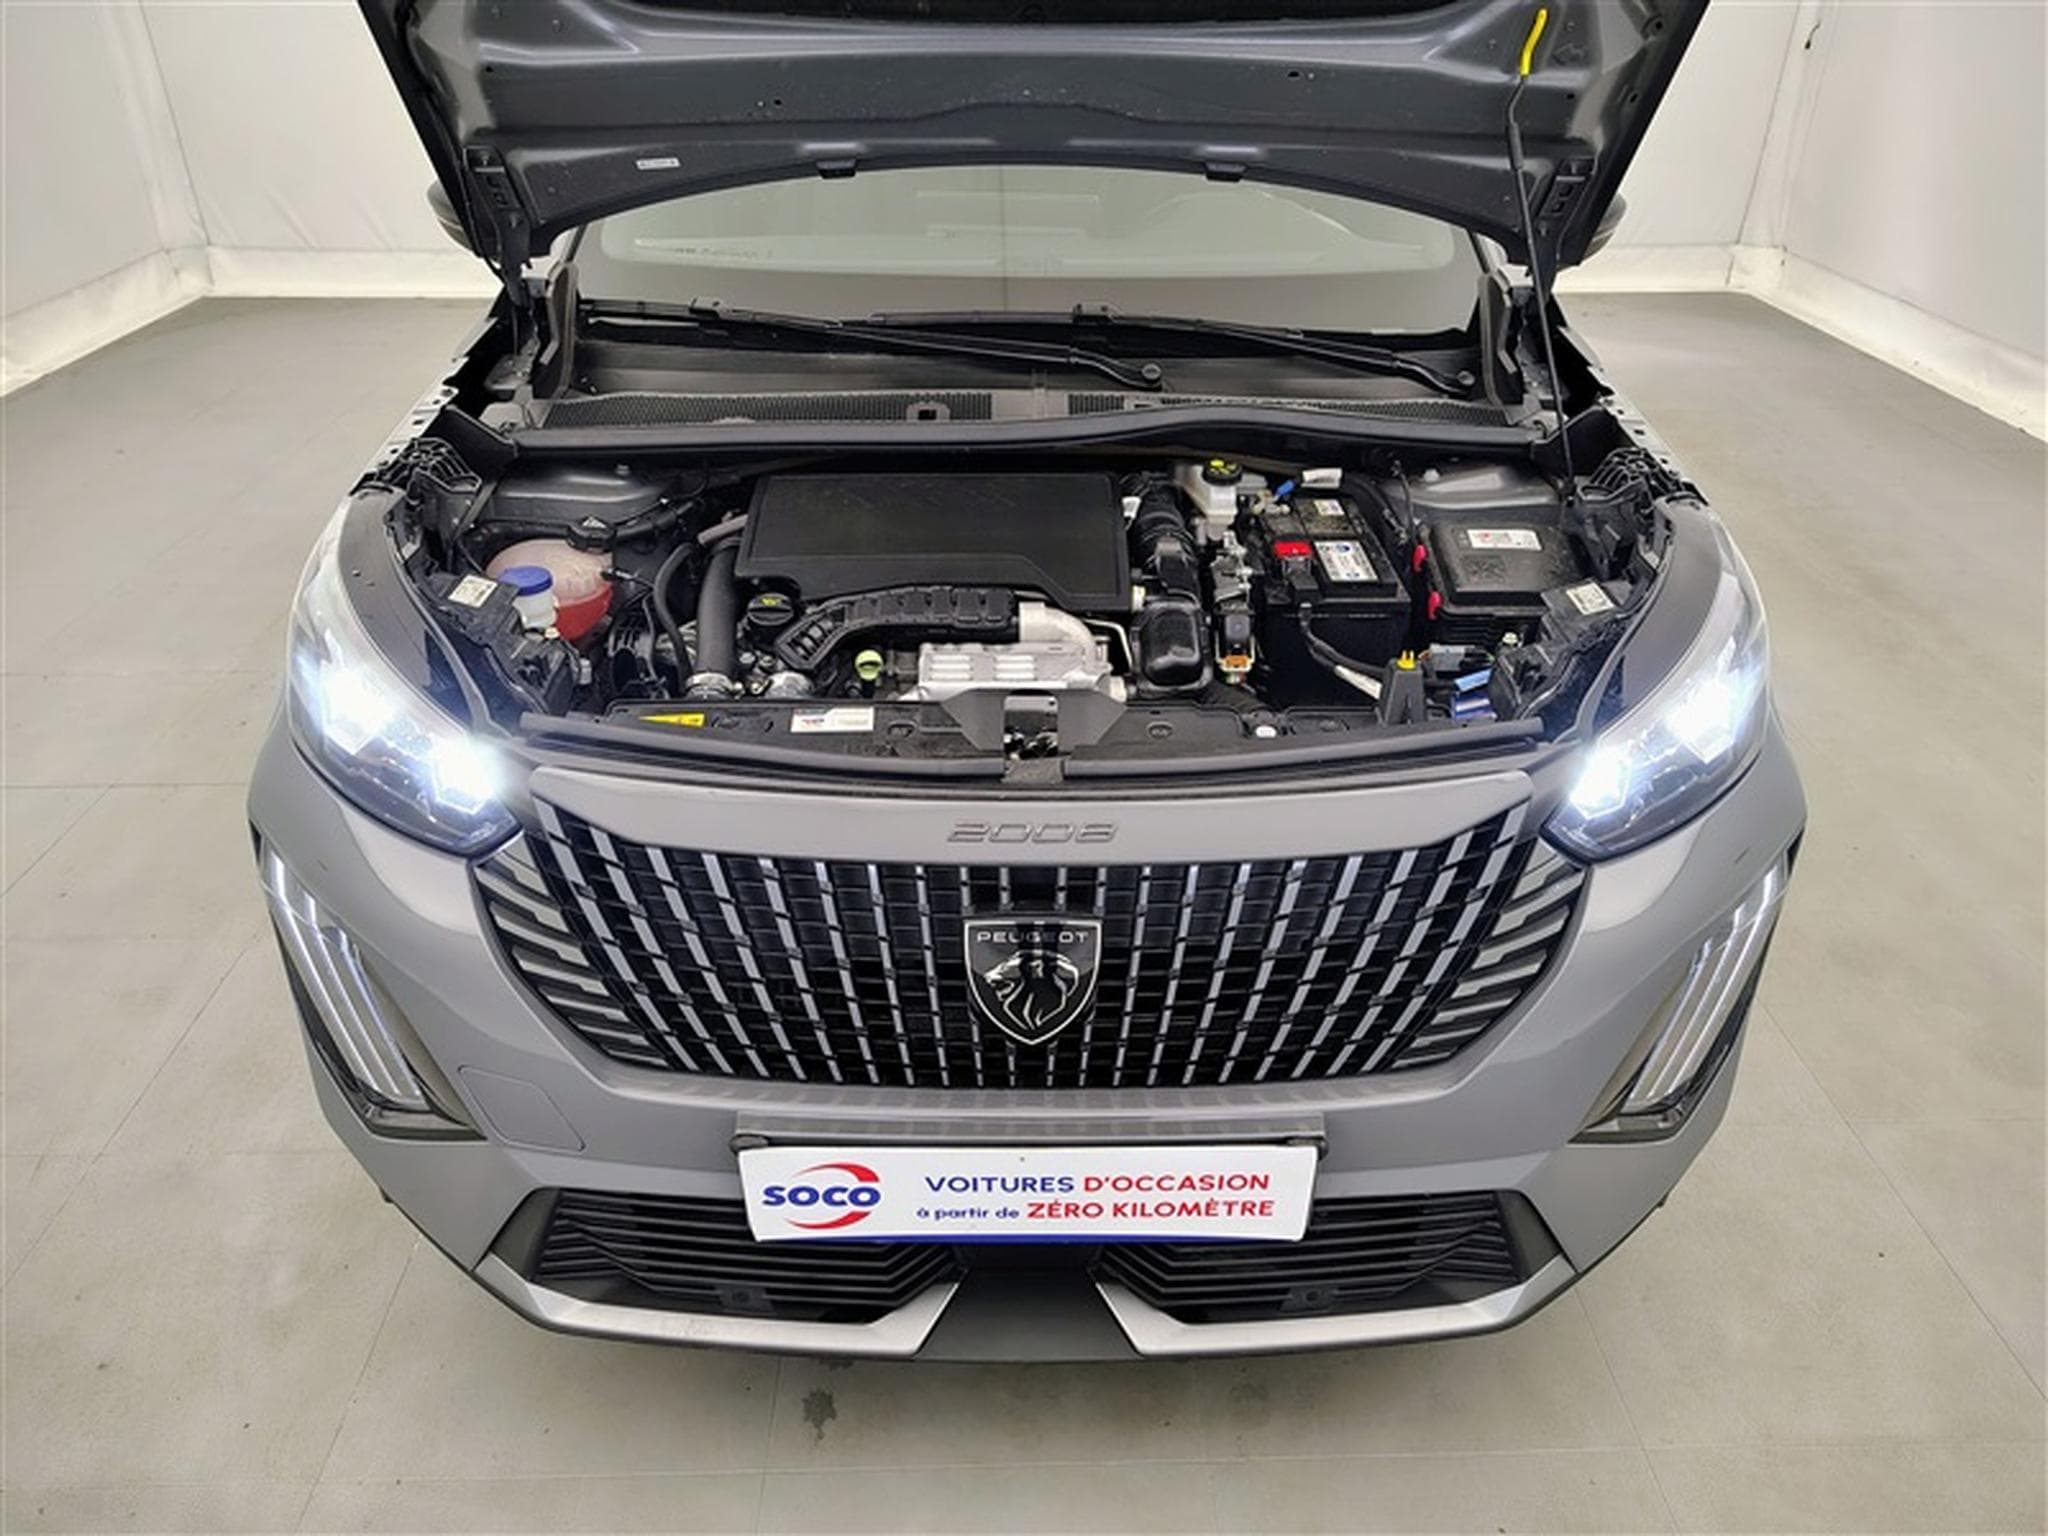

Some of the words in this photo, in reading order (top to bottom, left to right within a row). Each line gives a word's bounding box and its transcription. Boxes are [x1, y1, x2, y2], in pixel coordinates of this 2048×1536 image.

[947, 822, 1117, 844] 2008
[976, 930, 1089, 944] PEUGEOT
[925, 1175, 1075, 1194] VOITURES
[1083, 1174, 1270, 1193] D'OCCASION
[761, 1185, 881, 1208] SOCO
[916, 1206, 930, 1220] à
[934, 1206, 989, 1221] partir
[995, 1206, 1020, 1219] de
[1026, 1198, 1104, 1220] ZÉRO
[1112, 1197, 1275, 1218] KILOMÈTRE
